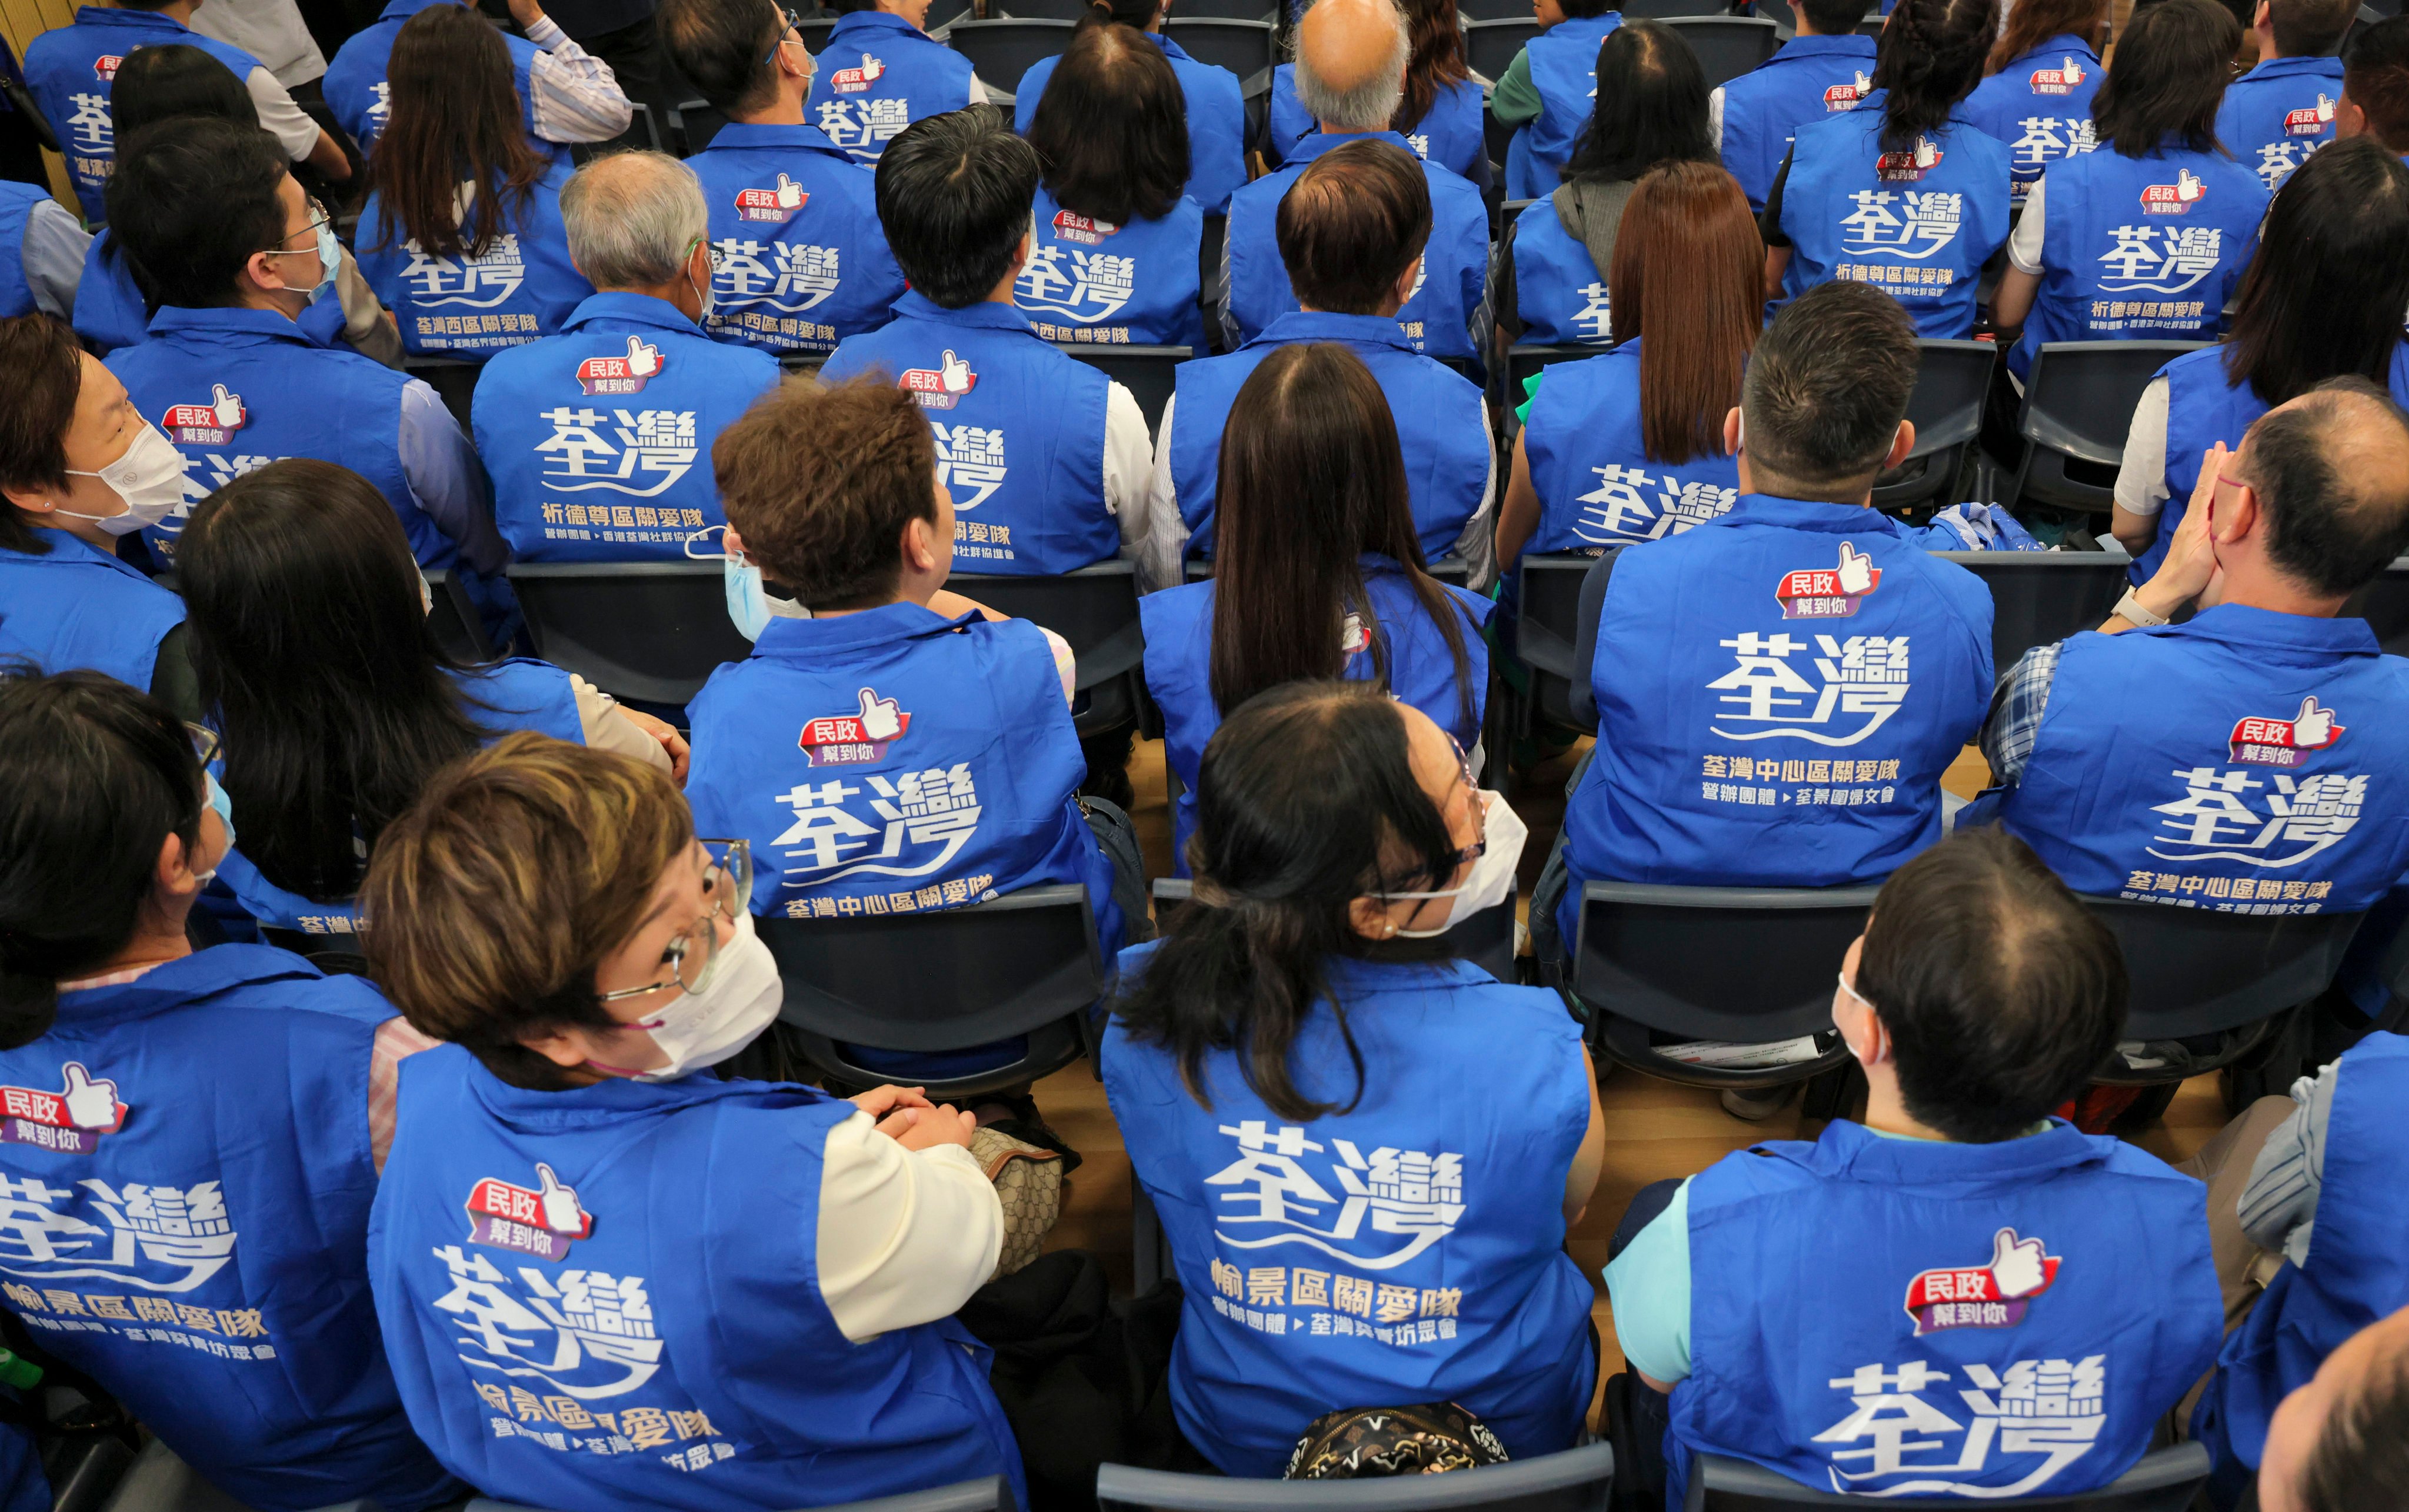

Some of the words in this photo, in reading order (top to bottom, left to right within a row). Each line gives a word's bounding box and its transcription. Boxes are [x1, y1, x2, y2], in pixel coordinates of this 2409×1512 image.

[839, 71, 860, 82] 民政
[841, 82, 867, 92] 幫到你
[2038, 72, 2061, 83] 民政
[1831, 88, 1853, 99] 民政
[2040, 84, 2067, 94] 幫到你
[815, 98, 911, 159] 荃灣
[2292, 111, 2315, 123] 民政
[2293, 124, 2321, 134] 幫到你
[745, 191, 774, 207] 民政
[2150, 187, 2175, 201] 民政
[749, 208, 782, 221] 幫到你
[2151, 202, 2182, 213] 幫到你
[1063, 212, 1089, 229] 民政
[1839, 189, 1962, 259] 荃灣
[1064, 228, 1095, 243] 幫到你
[399, 234, 525, 308] 荃灣
[2097, 225, 2223, 294] 荃灣
[711, 238, 840, 312] 荃灣
[1013, 243, 1135, 323] 荃灣
[1835, 264, 1954, 285] 祈德尊區關愛隊
[2091, 301, 2205, 318] 祈德尊區關愛隊
[416, 314, 539, 334] 荃灣西區關愛隊
[589, 361, 624, 377] 民政
[594, 379, 635, 392] 幫到你
[909, 372, 938, 391] 民政
[176, 408, 211, 426] 民政
[182, 428, 224, 443] 幫到你
[534, 407, 699, 497] 荃灣
[541, 502, 705, 528] 祈德尊區關愛隊
[1572, 464, 1739, 545] 荃灣
[1791, 572, 1834, 595] 民政
[1796, 597, 1847, 615] 幫到你
[1705, 631, 1911, 747] 荃灣
[814, 720, 858, 743] 民政
[2242, 720, 2289, 744] 民政
[822, 744, 875, 762] 幫到你
[2241, 744, 2295, 765] 幫到你
[1702, 754, 1901, 783] 荃灣中心區關愛隊
[1702, 781, 1776, 806] 營辦團體
[769, 762, 982, 887] 荃灣
[2144, 767, 2371, 868] 荃灣
[784, 872, 994, 919] 荃灣中心區關愛隊
[2125, 870, 2333, 900] 荃灣中心區關愛隊
[5, 1090, 59, 1124] 民政
[16, 1119, 81, 1150] 幫到你
[486, 1183, 537, 1224] 民政
[1204, 1120, 1466, 1270] 荃灣
[0, 1173, 237, 1292] 荃灣
[489, 1217, 552, 1255] 幫到你
[1211, 1257, 1463, 1323] 愉景區關愛隊
[1925, 1272, 1988, 1301] 民政
[2, 1281, 269, 1338] 愉景區關愛隊
[1932, 1303, 2008, 1326] 幫到你
[433, 1245, 664, 1399] 荃灣
[1811, 1354, 2107, 1498] 荃灣
